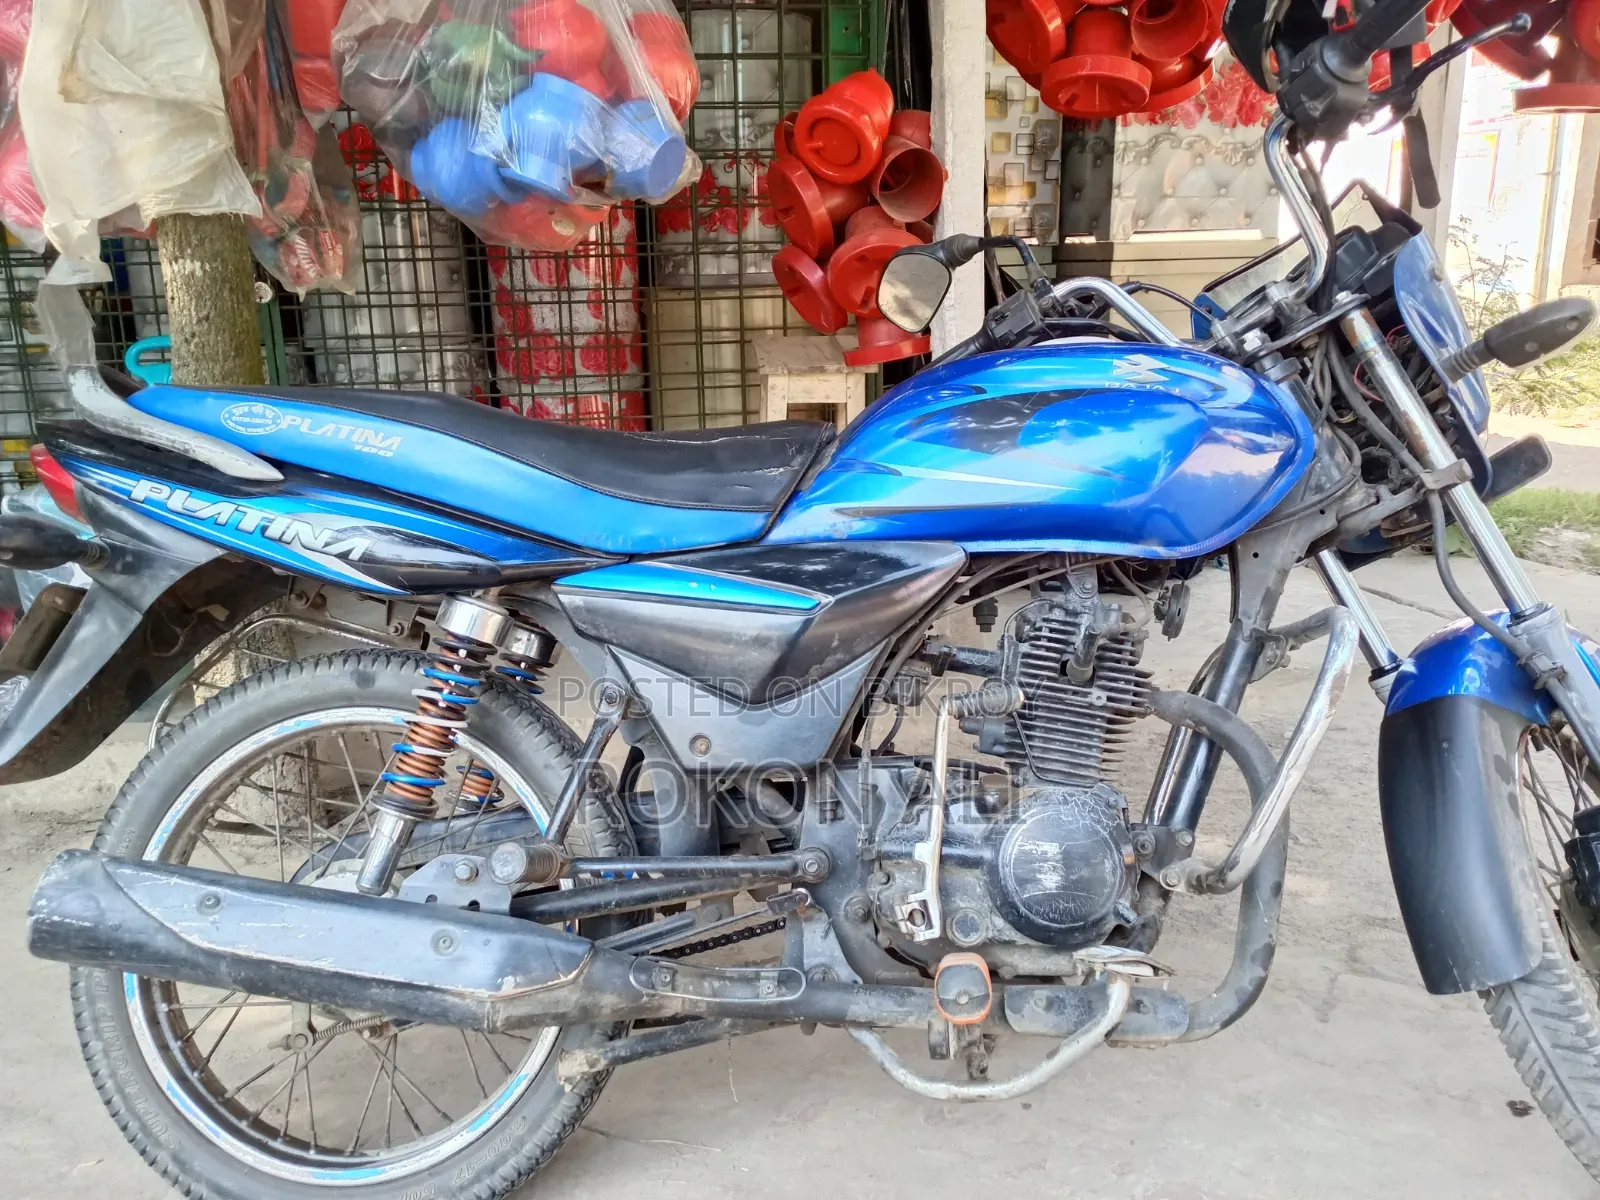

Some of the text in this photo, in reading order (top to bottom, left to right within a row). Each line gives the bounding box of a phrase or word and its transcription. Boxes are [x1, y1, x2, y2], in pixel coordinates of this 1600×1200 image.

[280, 415, 402, 450] PLATINA
[352, 444, 395, 458] 100
[129, 478, 378, 561] PLATINA
[117, 827, 136, 857] YLON
[453, 1115, 527, 1185] 3.00-17
